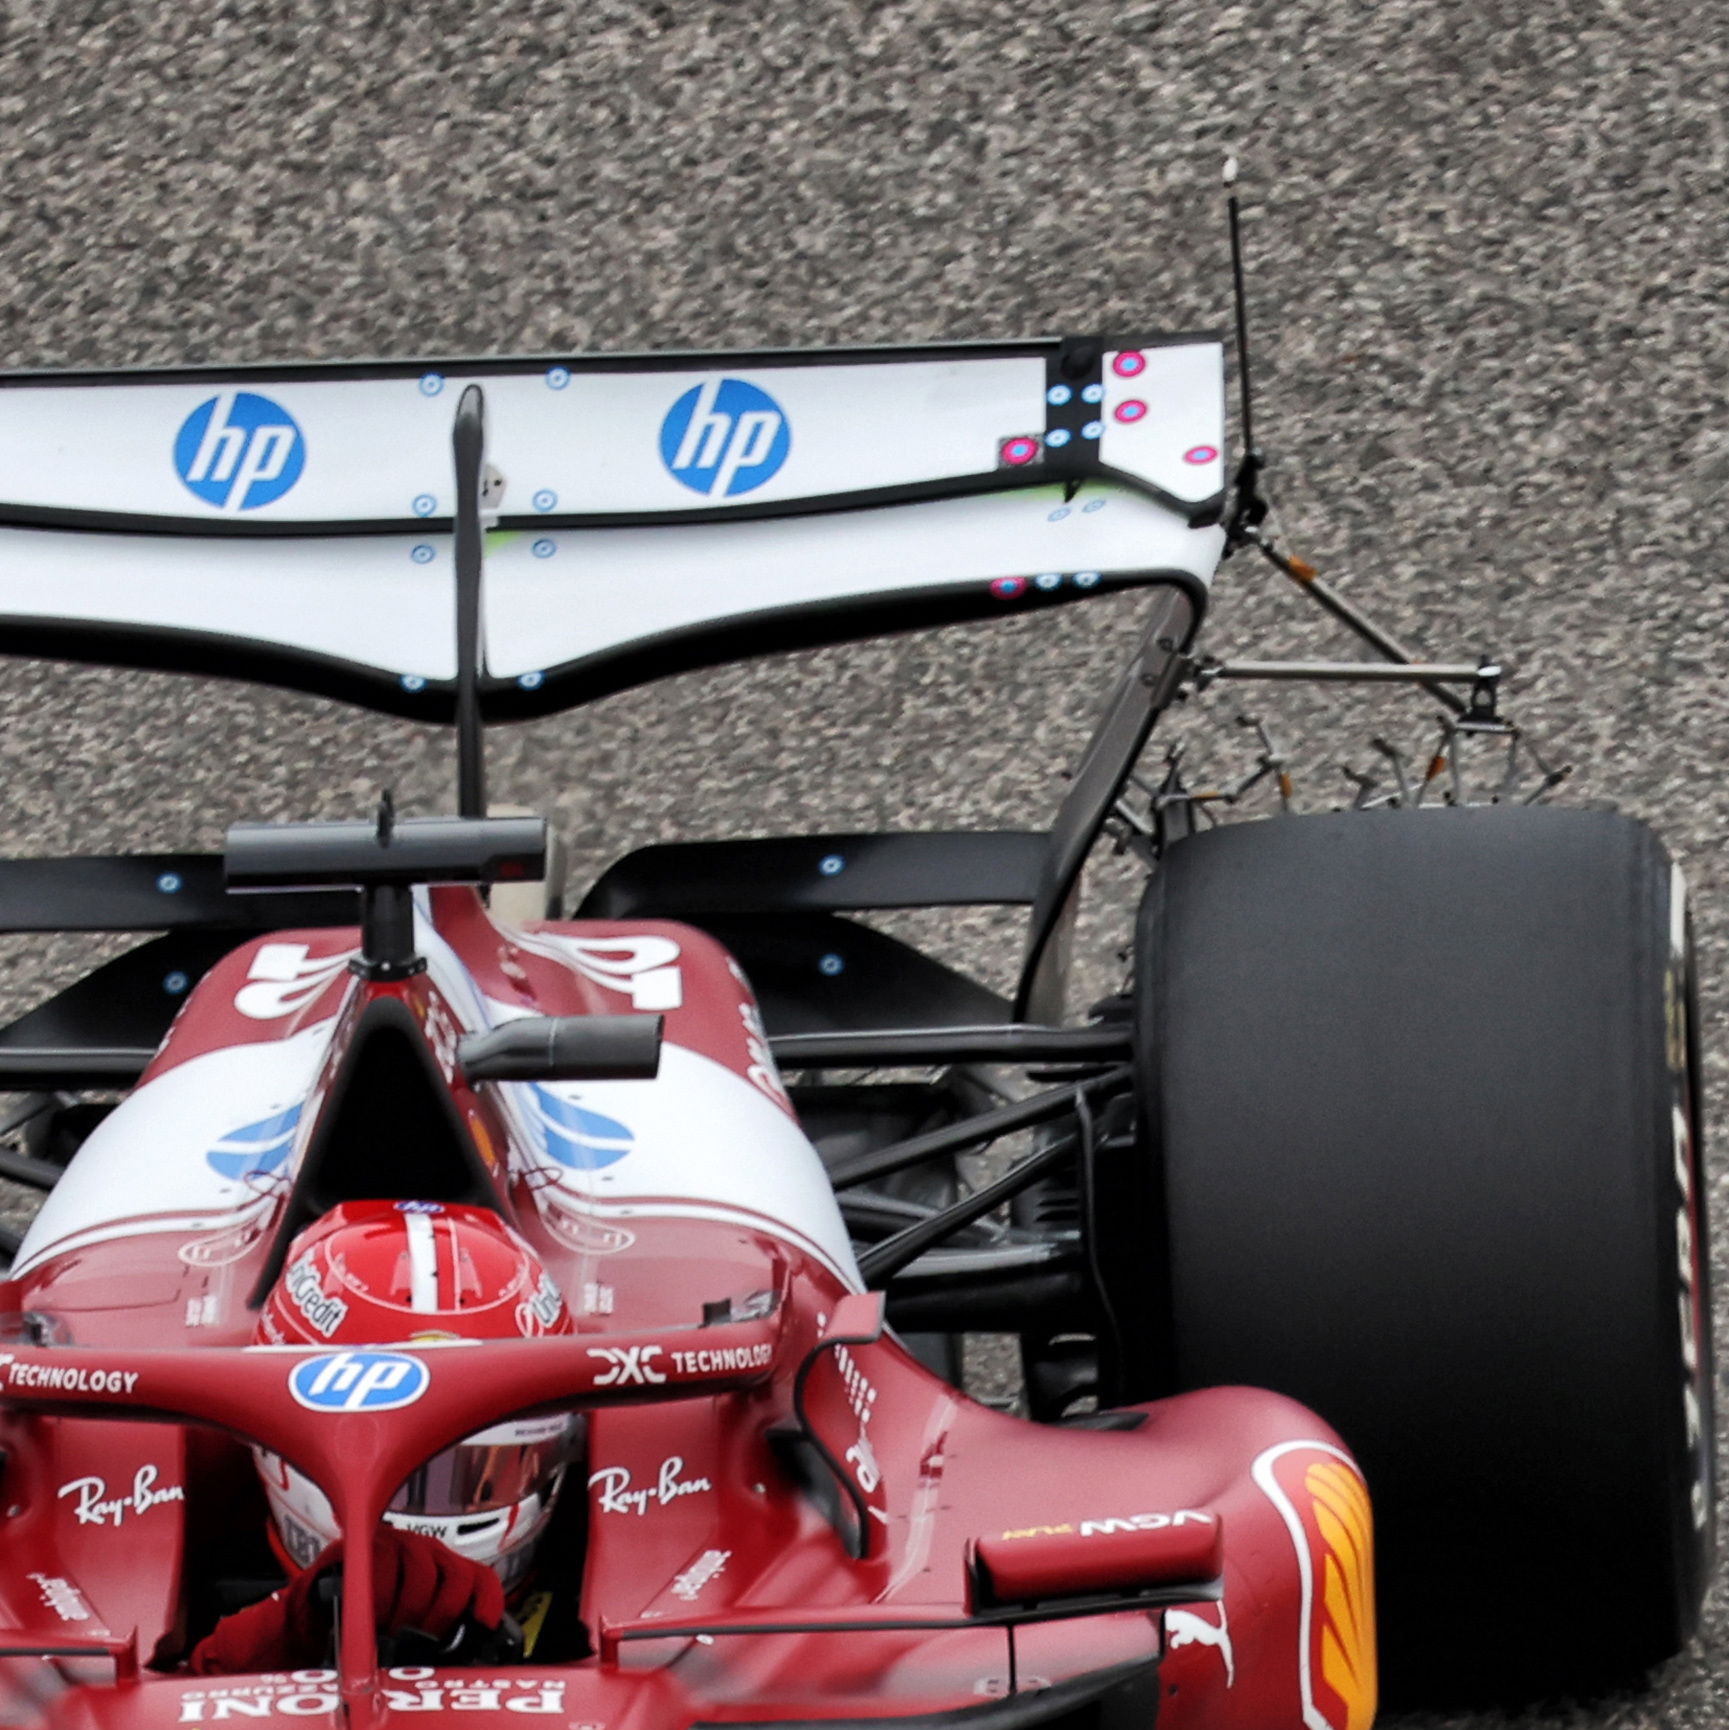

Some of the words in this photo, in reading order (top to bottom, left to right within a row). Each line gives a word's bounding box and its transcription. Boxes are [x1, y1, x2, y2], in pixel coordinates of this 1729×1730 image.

[186, 391, 296, 510] hp
[671, 379, 782, 496] hp
[8, 1362, 139, 1393] TECHNOLOGY
[308, 1353, 413, 1409] hp
[585, 1344, 667, 1386] DXC
[671, 1343, 772, 1374] TECHNOLOG
[1079, 1509, 1214, 1537] VGW
[178, 1689, 566, 1723] PERONI
